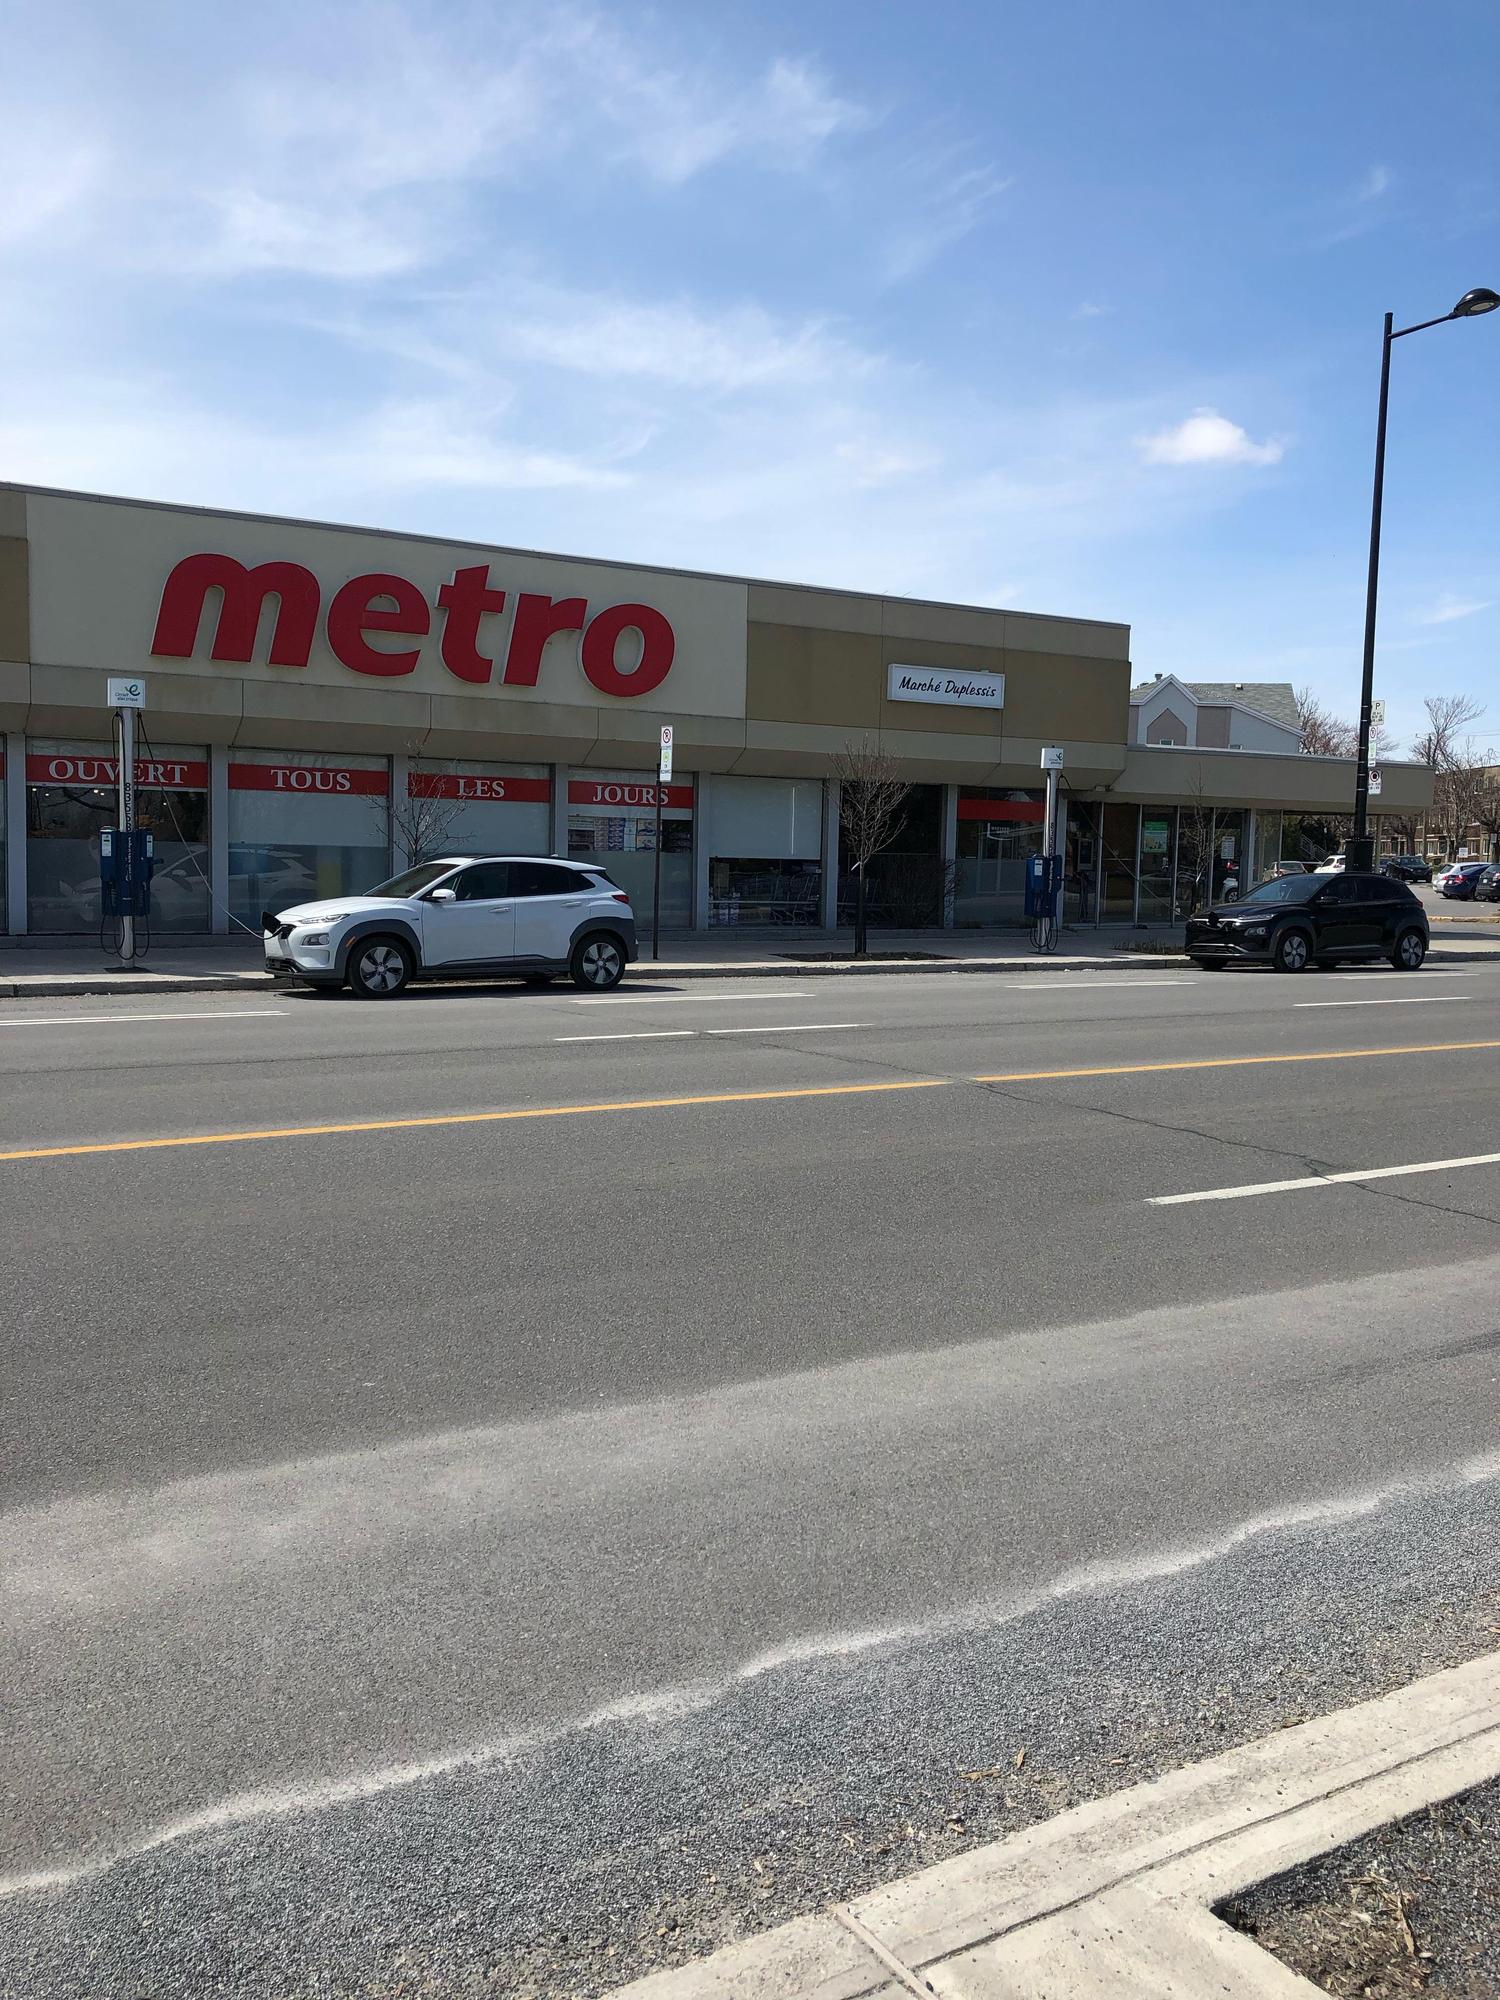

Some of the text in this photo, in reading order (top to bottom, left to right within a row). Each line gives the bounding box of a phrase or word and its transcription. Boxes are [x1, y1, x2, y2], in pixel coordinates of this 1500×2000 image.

[150, 553, 676, 697] metro
[898, 675, 997, 699] Marché Duplessis
[1375, 702, 1381, 710] P
[48, 759, 669, 805] OUVERT TOUS LES JOURS
